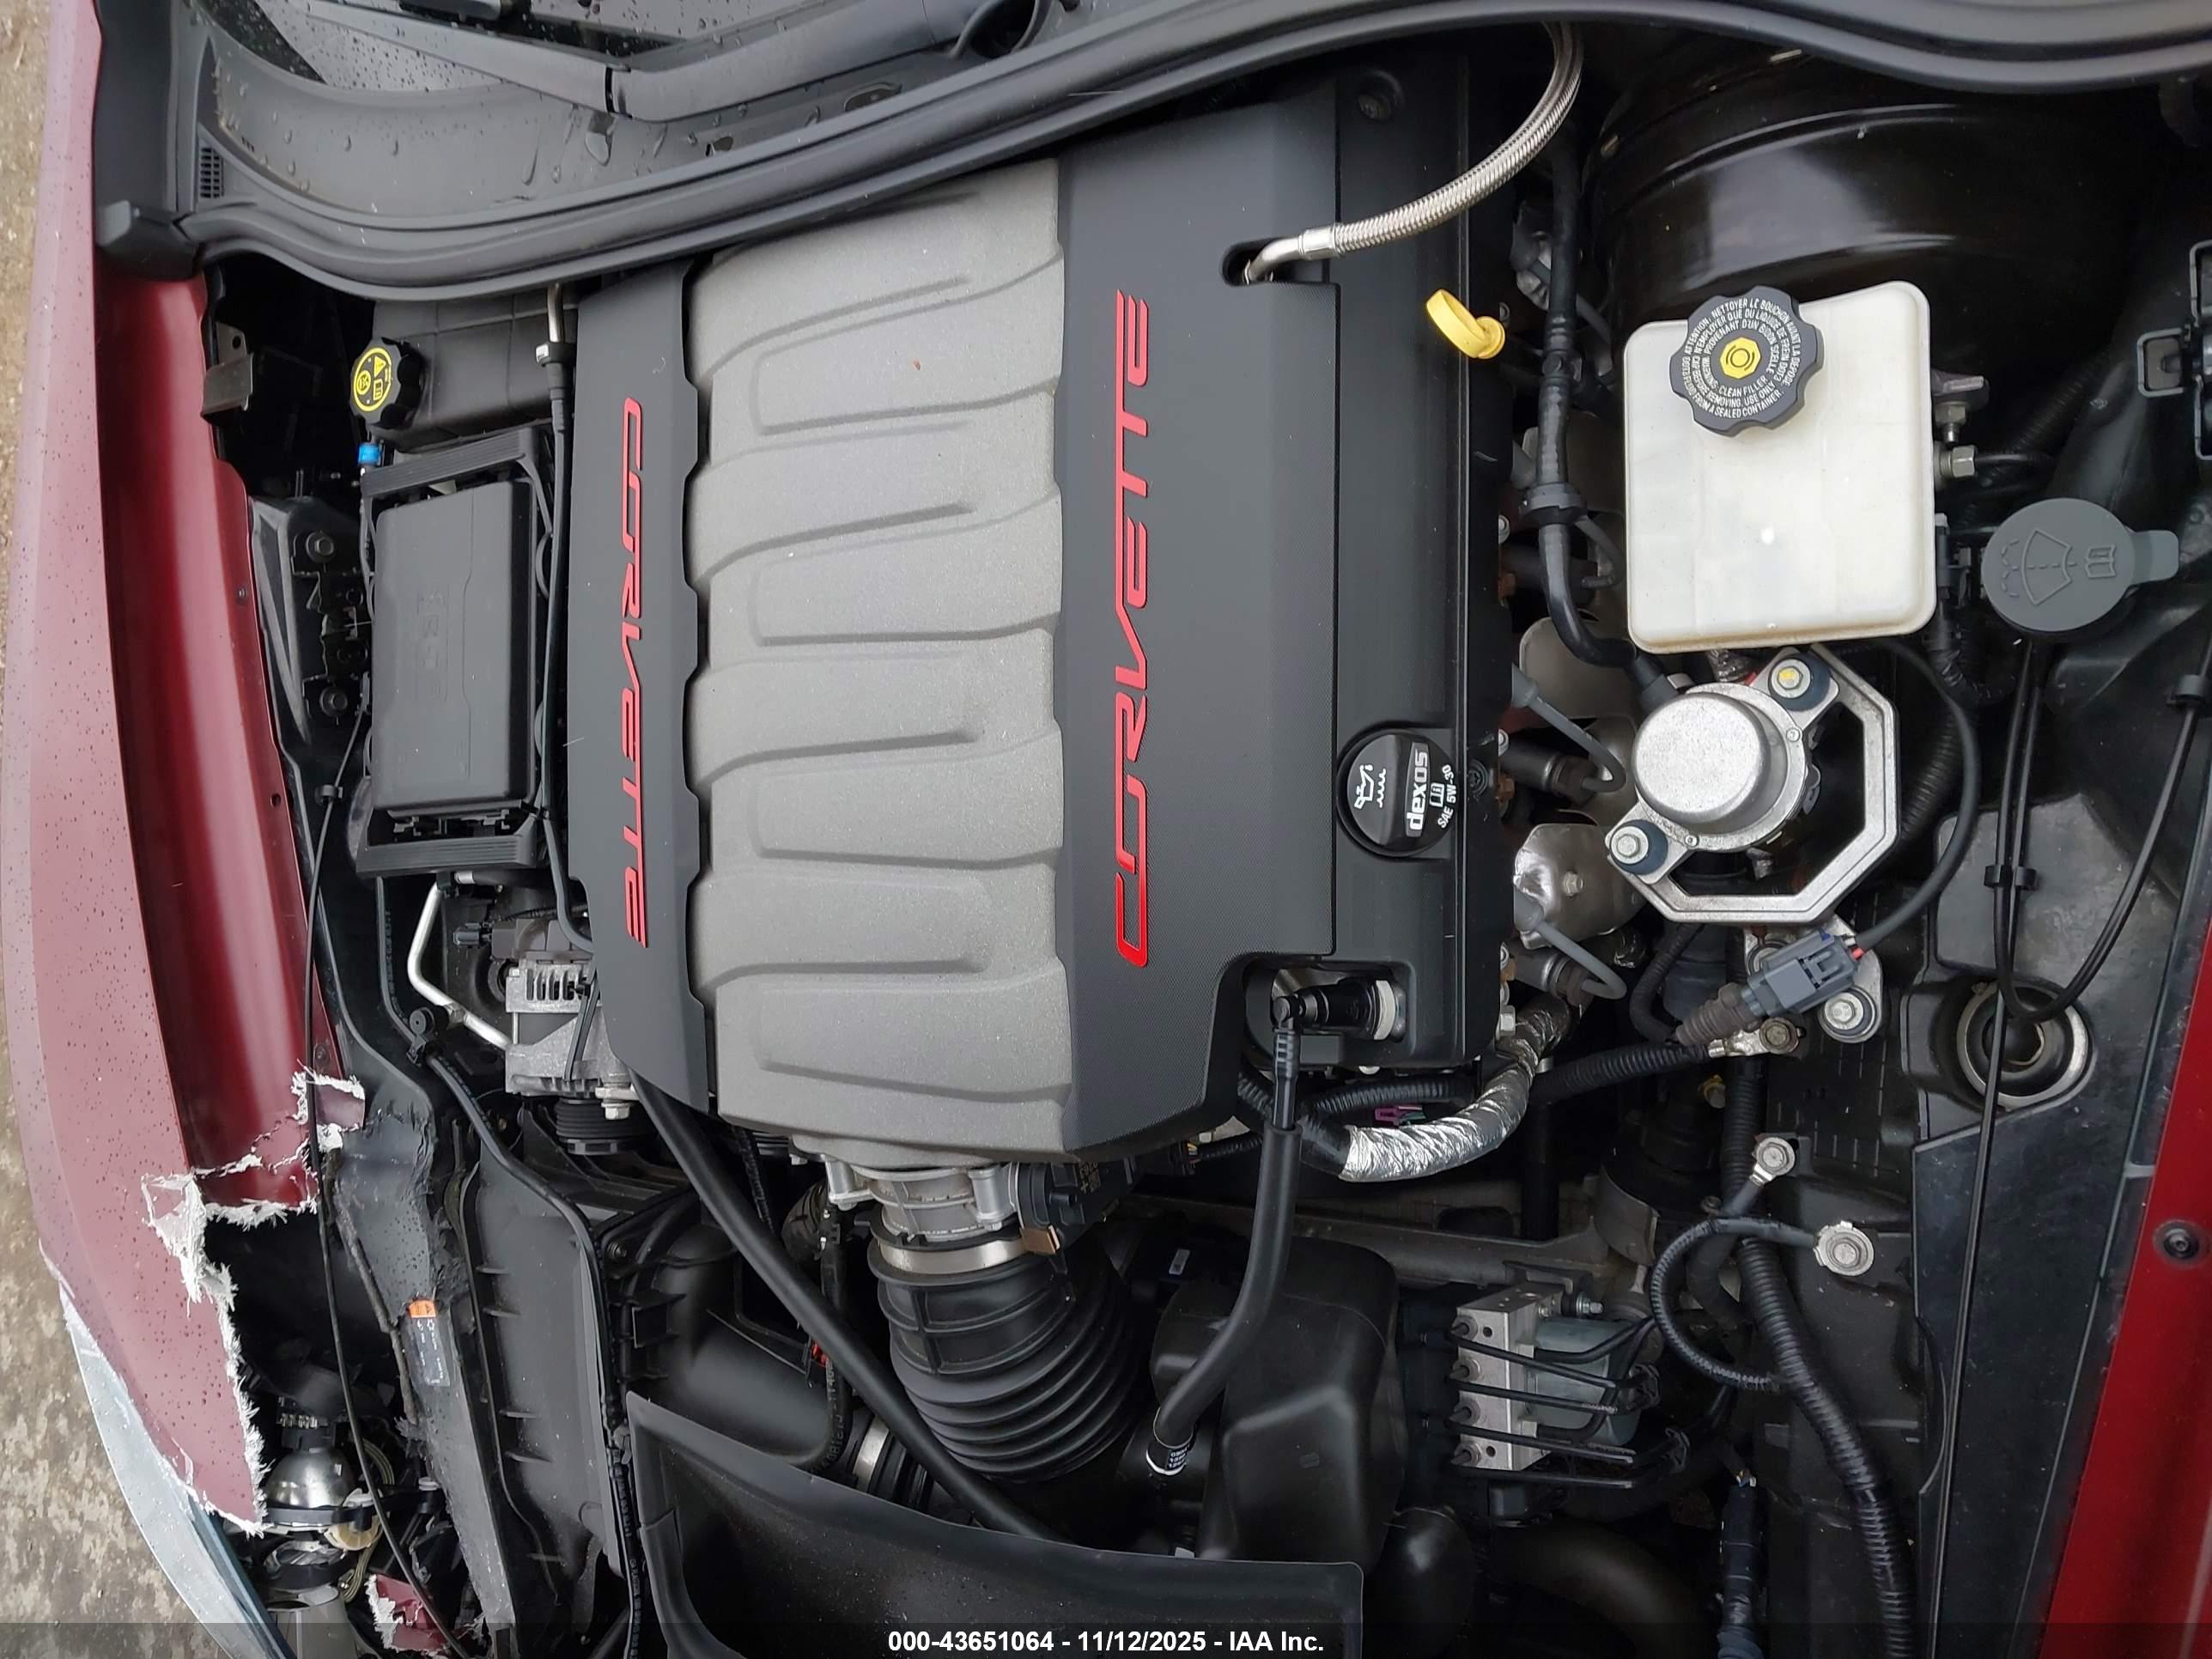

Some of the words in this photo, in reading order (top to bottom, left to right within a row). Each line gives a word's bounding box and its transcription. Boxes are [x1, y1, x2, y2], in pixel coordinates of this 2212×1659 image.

[1704, 321, 1739, 355] PROVENANT
[1711, 299, 1747, 319] NETTOYER
[1792, 345, 1801, 356] LA
[1728, 310, 1742, 321] QUE
[1745, 309, 1754, 319] DU
[1777, 327, 1787, 339] DE
[1692, 392, 1711, 411] FROM
[1709, 405, 1715, 414] A
[1715, 406, 1741, 418] SEALED
[1719, 386, 1741, 397] CLEAN
[1744, 394, 1759, 405] USE
[1759, 380, 1776, 398] ONLY
[1115, 289, 1149, 968] CORVETTE
[622, 397, 647, 948] CORVETTE
[1407, 748, 1429, 830] dexos
[1442, 763, 1457, 804] 5W-30
[1437, 805, 1454, 829] SAE
